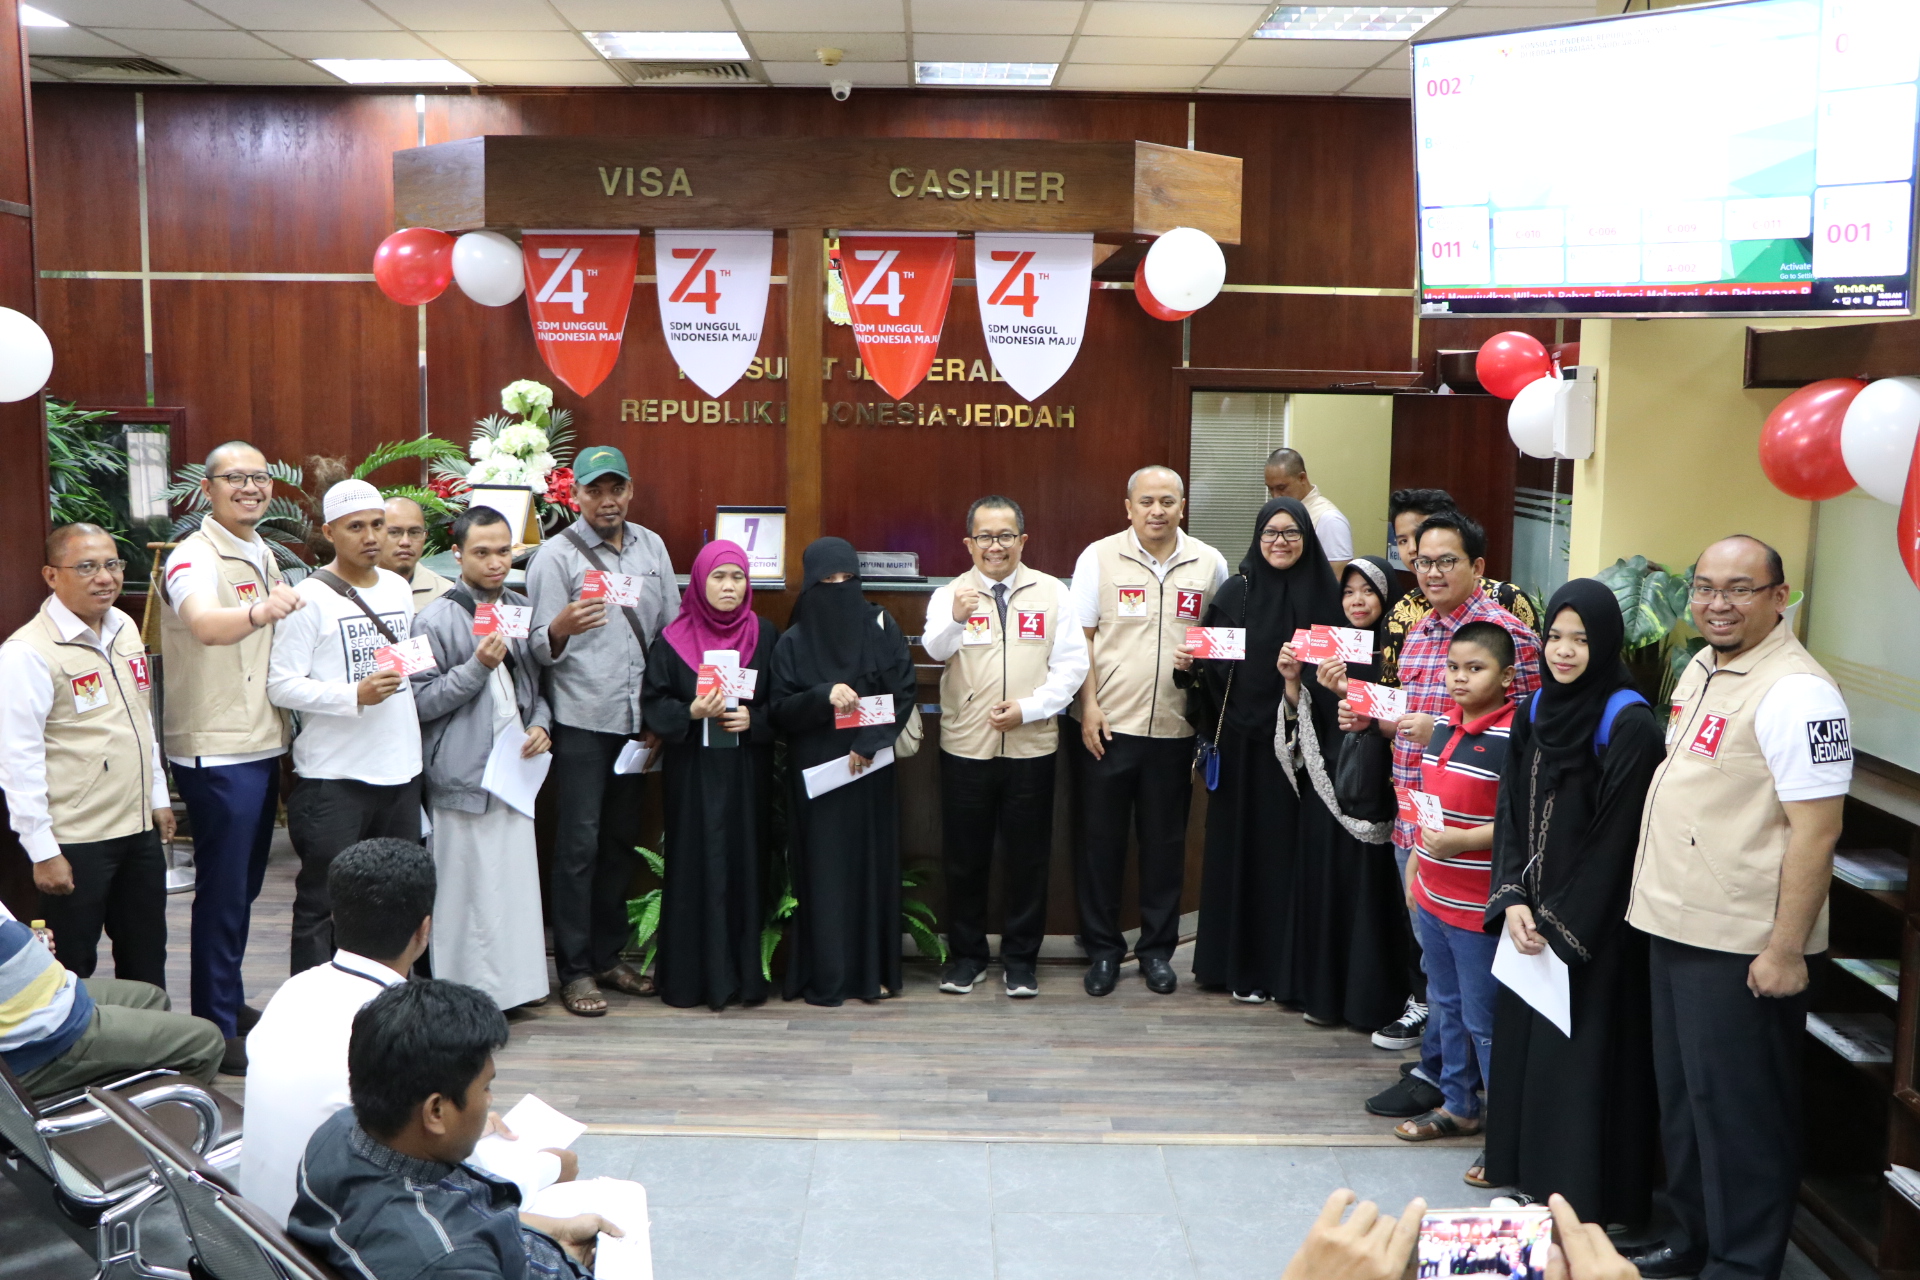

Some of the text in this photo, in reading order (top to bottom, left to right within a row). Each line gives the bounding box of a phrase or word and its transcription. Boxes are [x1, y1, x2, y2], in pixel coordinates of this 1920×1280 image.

[1426, 77, 1462, 97] 002
[598, 166, 694, 197] VISA
[889, 167, 1065, 202] CASHIER
[1827, 223, 1871, 243] 001
[1431, 241, 1461, 258] 011
[1780, 262, 1812, 271] Activate
[537, 321, 608, 331] SDM UNGGUL
[669, 321, 741, 331] SDM UNGGUL
[855, 323, 924, 333] SDM UNGGUL
[988, 324, 1058, 334] SDM UNGGUL
[538, 332, 622, 342] INDONESIA MAJU
[671, 332, 758, 342] INDONESIA MAJU
[855, 334, 939, 344] INDONESIA MAJU
[989, 335, 1077, 346] INDONESIA MAJU
[847, 357, 1008, 382] JERAL
[621, 399, 773, 424] REPUBLIK
[744, 518, 760, 551] 7
[860, 561, 885, 569] HYUNI
[347, 619, 406, 639] BAHGIA
[1808, 719, 1847, 744] KJRI
[1813, 741, 1850, 762] JEDDAH
